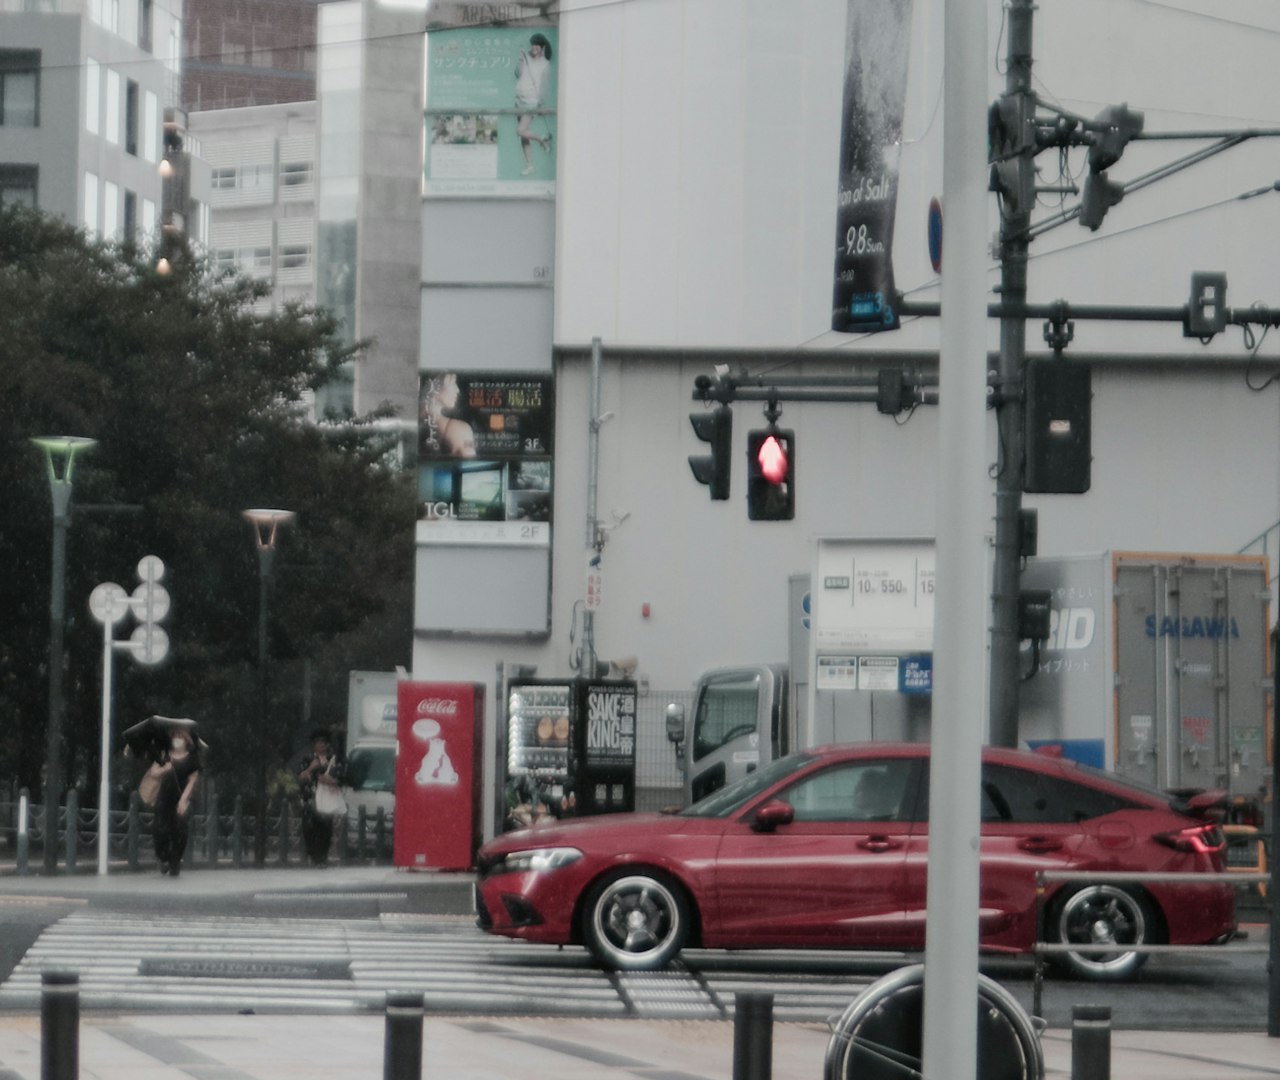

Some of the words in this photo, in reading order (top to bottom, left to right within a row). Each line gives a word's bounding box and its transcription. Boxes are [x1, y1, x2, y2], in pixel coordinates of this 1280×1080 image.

[434, 55, 512, 69] サンクチュアリ
[865, 174, 890, 201] Salt
[524, 437, 540, 450] 3F
[424, 502, 458, 518] TGL
[521, 526, 540, 538] 2F
[1145, 614, 1239, 638] SAGAWA
[589, 693, 620, 720] SAKE
[587, 720, 620, 748] KING
[620, 694, 634, 755] 酒皇帝
